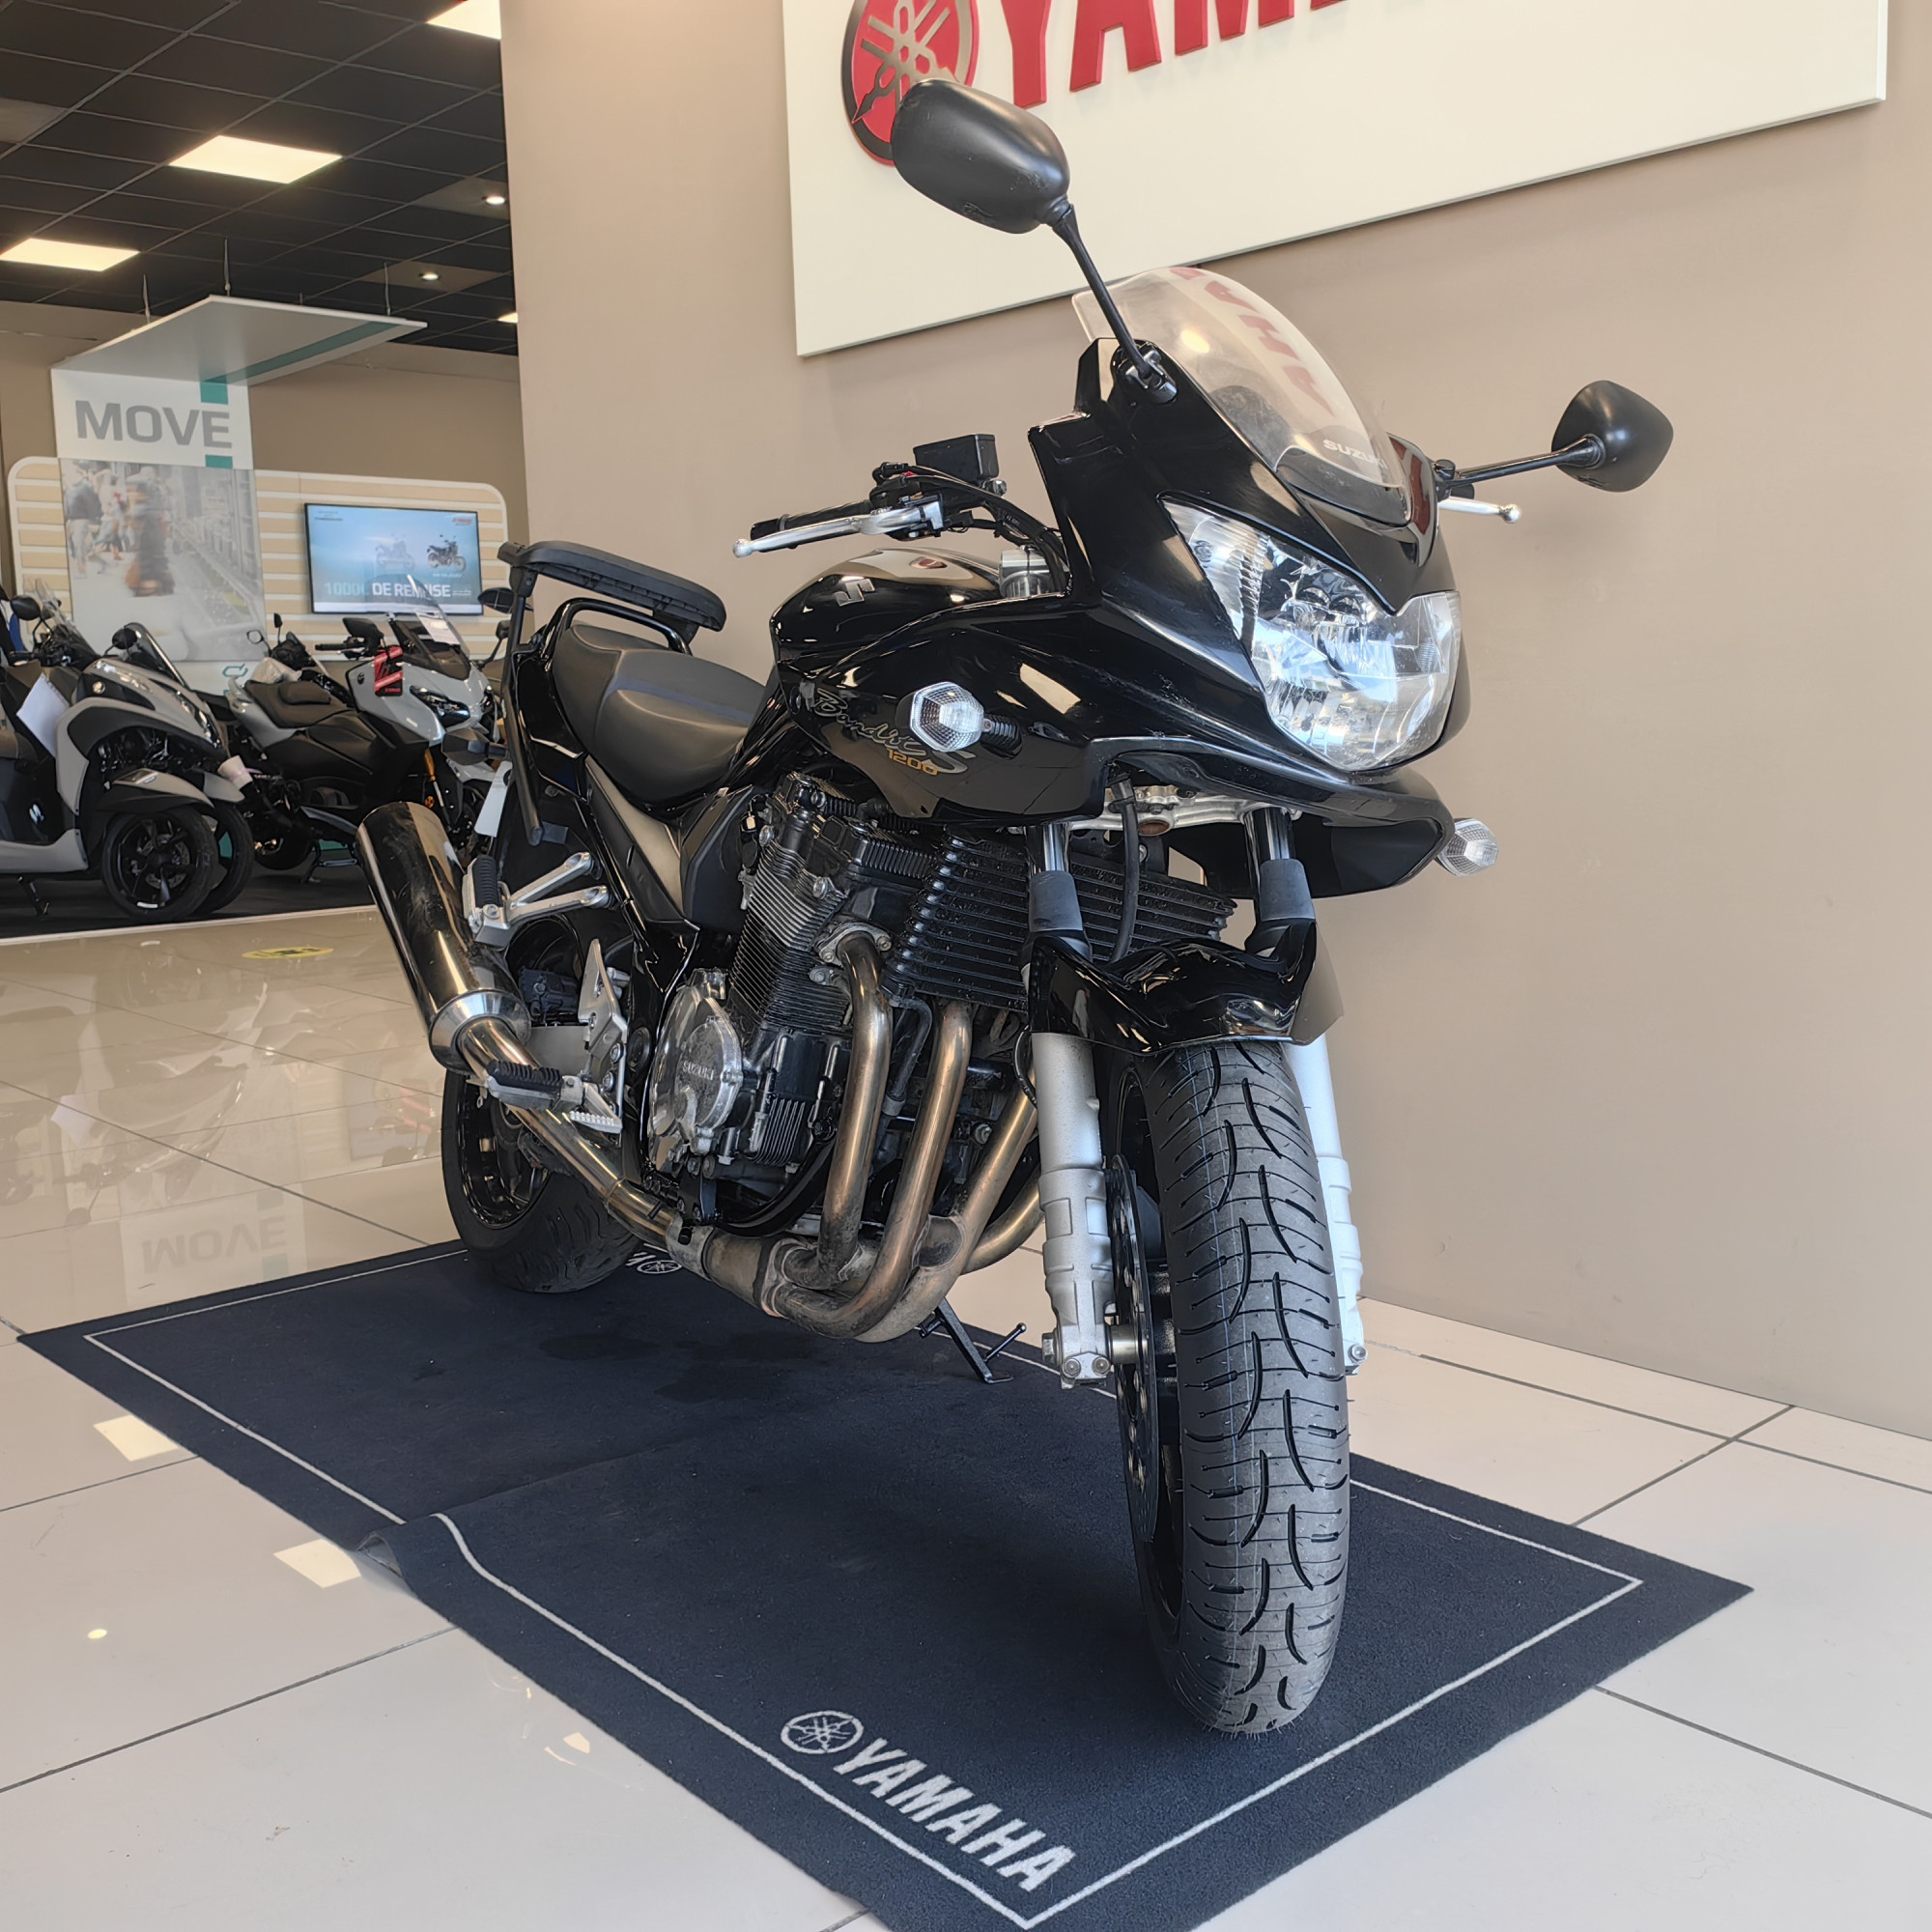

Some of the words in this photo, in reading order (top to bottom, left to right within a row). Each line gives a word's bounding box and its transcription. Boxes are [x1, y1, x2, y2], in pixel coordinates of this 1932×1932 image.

[75, 400, 233, 449] MOVE
[1322, 438, 1389, 470] SUZUKI
[372, 582, 391, 596] DE
[887, 748, 939, 776] 1200
[682, 1060, 715, 1081] SUZUKI
[833, 1738, 1076, 1892] YAMAHA
